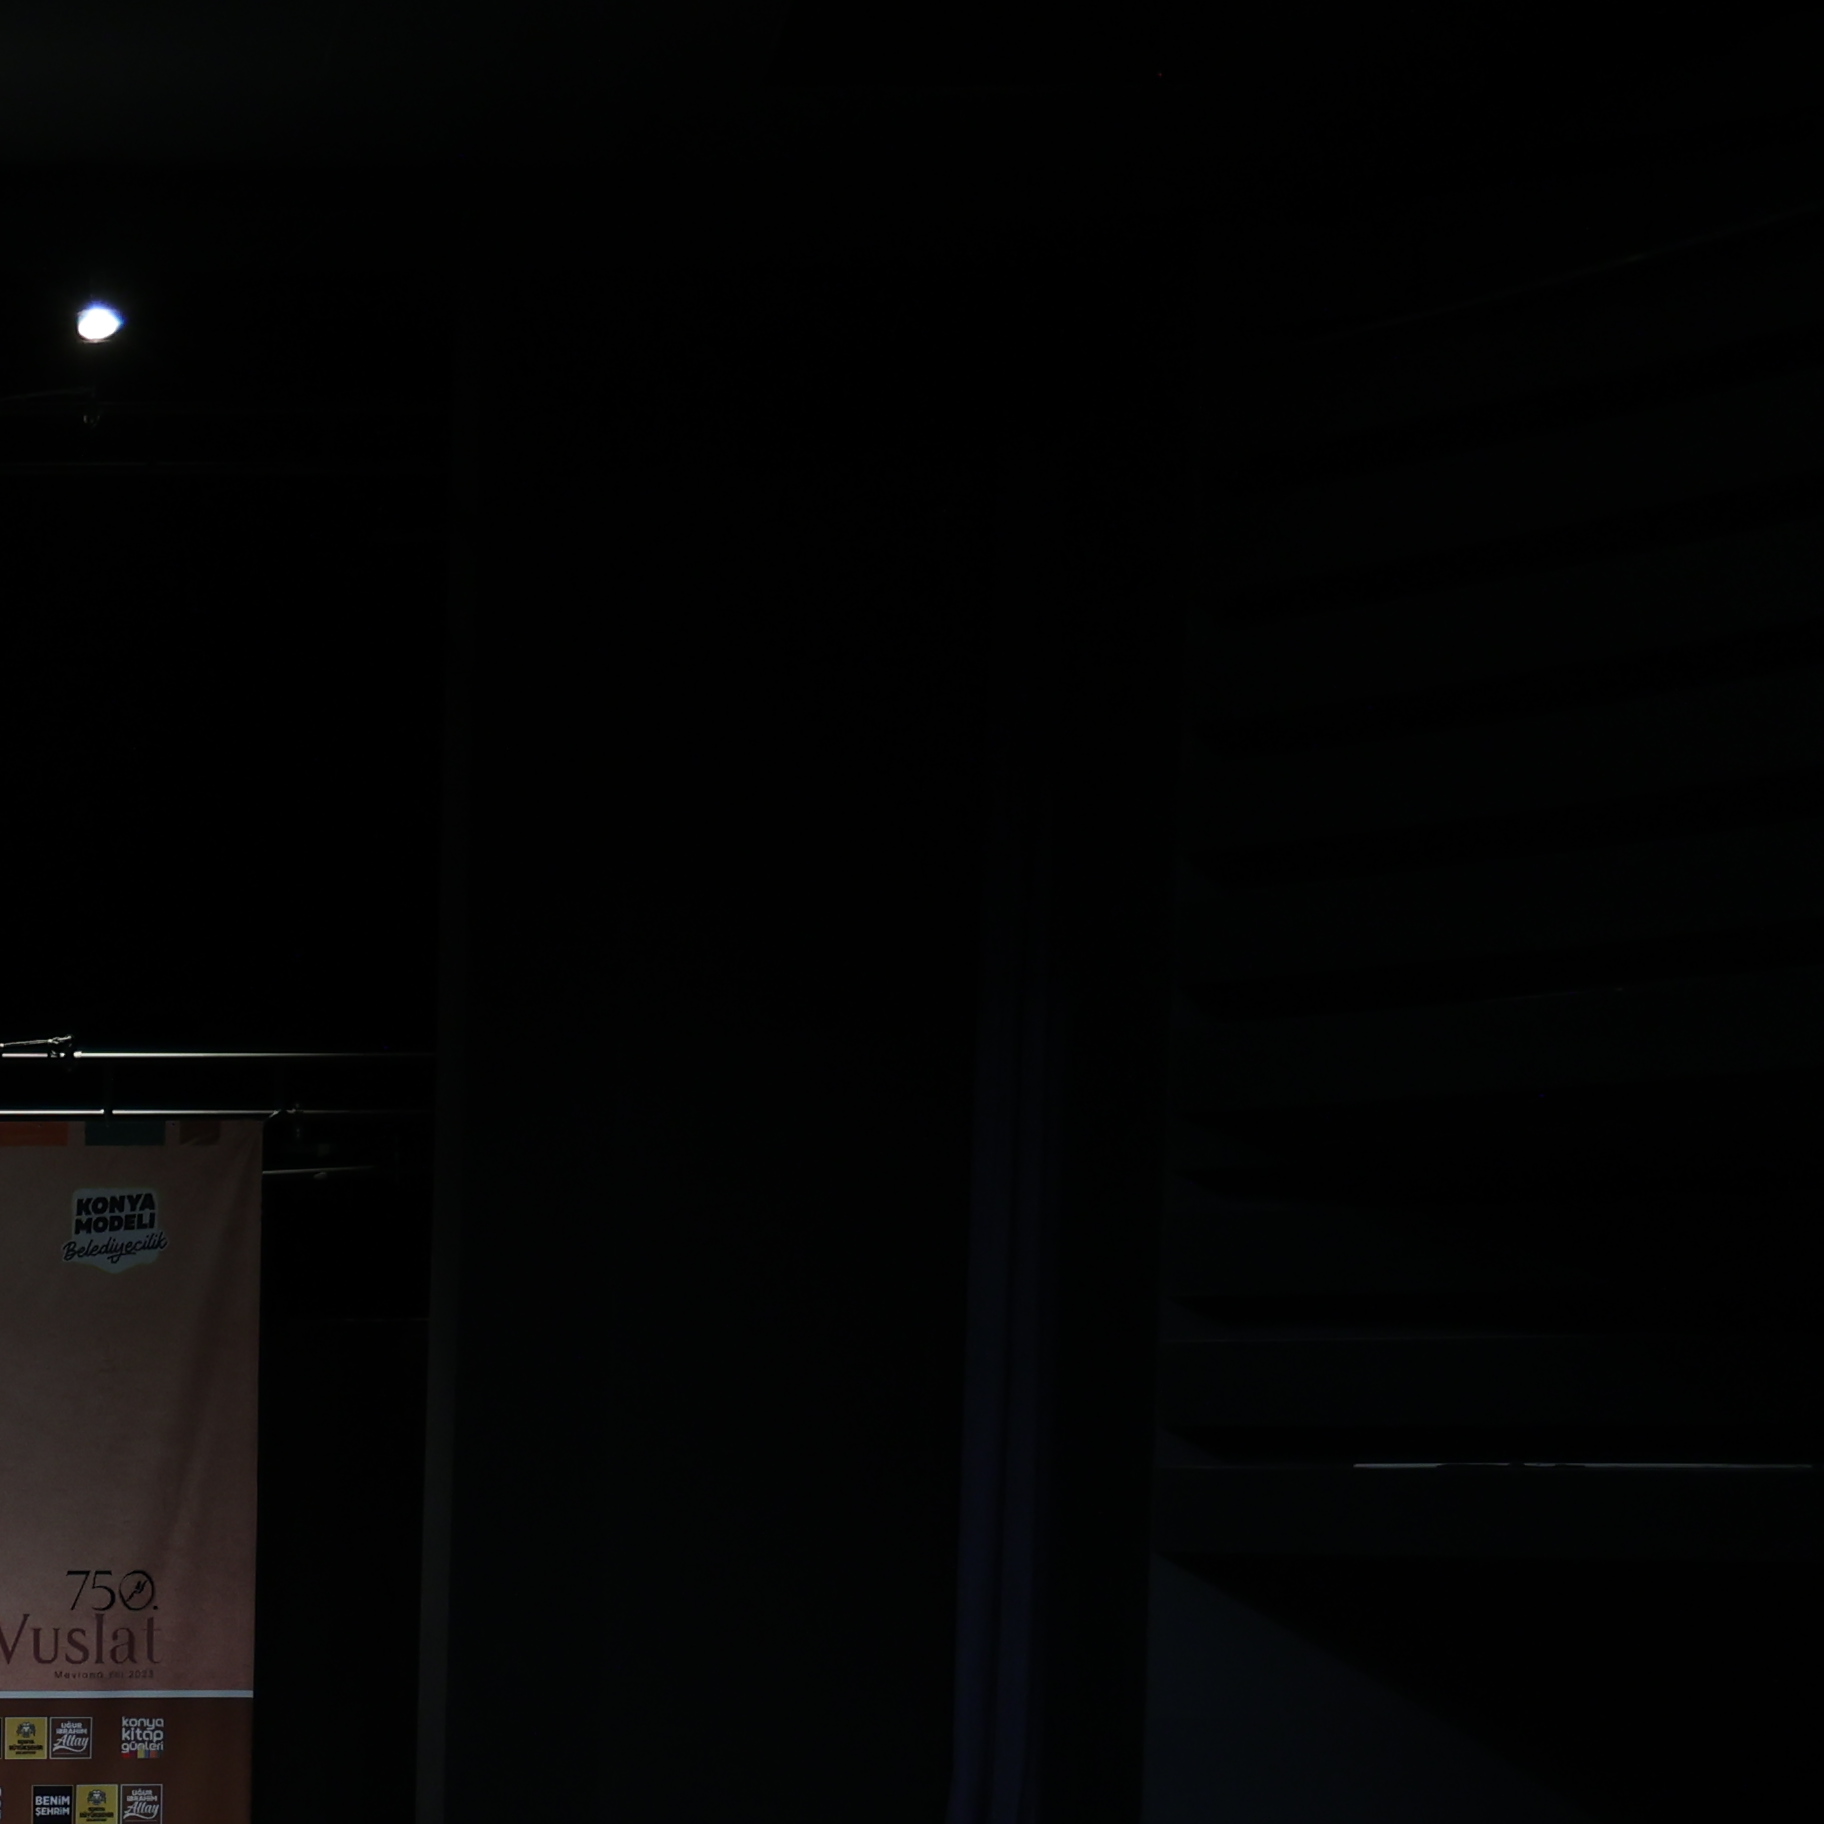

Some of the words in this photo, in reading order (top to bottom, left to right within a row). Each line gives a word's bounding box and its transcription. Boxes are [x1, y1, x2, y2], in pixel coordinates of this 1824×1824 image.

[76, 1193, 155, 1216] KONYA
[63, 1231, 168, 1264] Belediyecilik
[121, 1716, 165, 1730] konya
[121, 1729, 165, 1743] kitap
[121, 1742, 165, 1754] günleri
